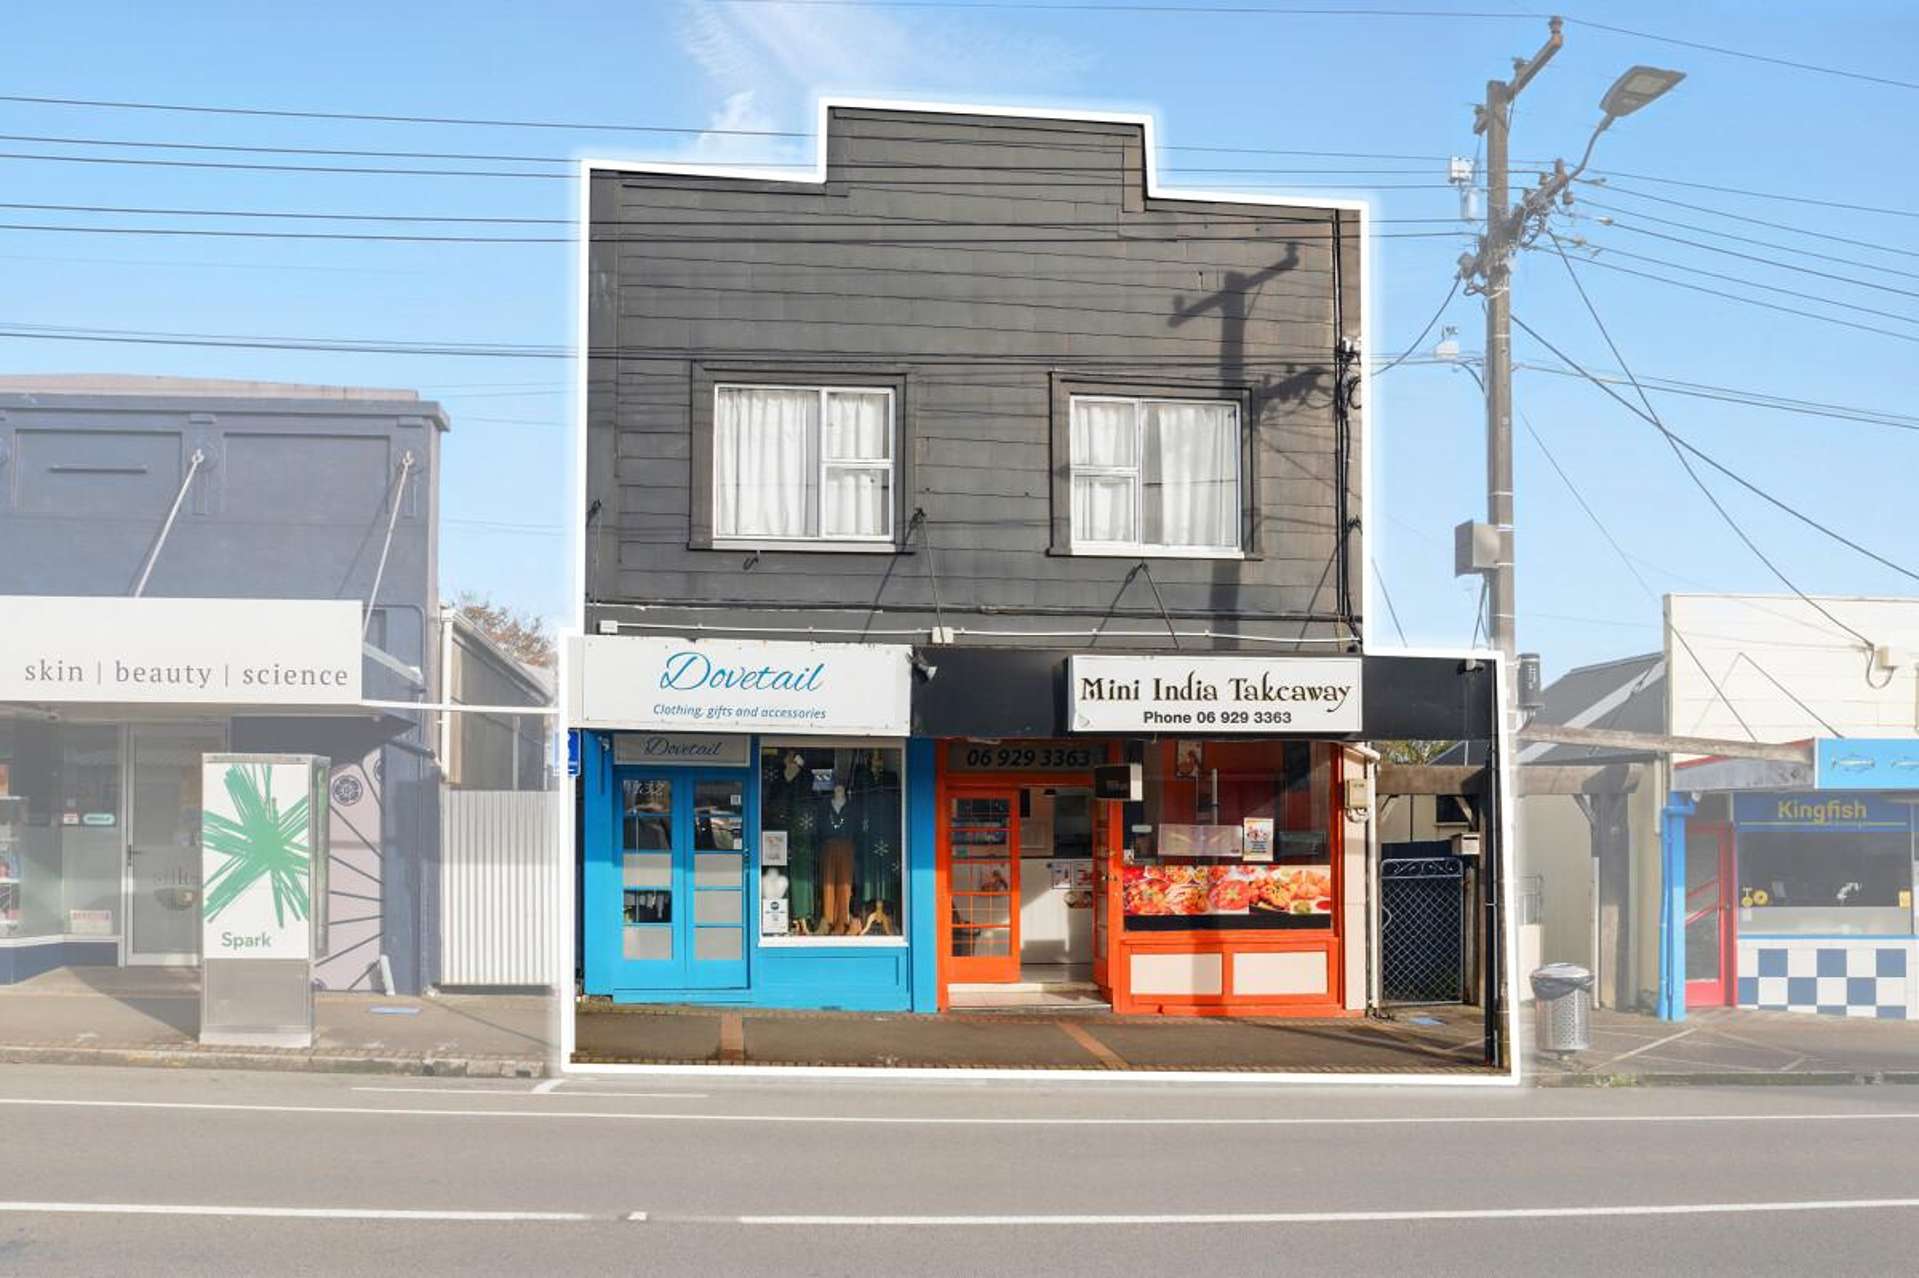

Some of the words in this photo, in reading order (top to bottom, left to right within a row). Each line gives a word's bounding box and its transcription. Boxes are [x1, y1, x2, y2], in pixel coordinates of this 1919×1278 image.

[24, 660, 84, 681] skin
[115, 661, 212, 688] beauty
[242, 664, 348, 686] science
[660, 652, 825, 691] Dovetail
[1081, 677, 1140, 700] Mini
[1152, 670, 1218, 701] India
[706, 705, 732, 719] gifts
[735, 706, 758, 718] and
[761, 707, 826, 719] accessories
[1143, 712, 1191, 724] Phone
[1197, 711, 1216, 724] 06
[1220, 711, 1249, 724] 929
[1254, 711, 1292, 724] 3363
[644, 736, 722, 756] Dovetail
[967, 750, 991, 767] 06
[997, 750, 1035, 767] 929
[1040, 750, 1090, 767] 3363
[1778, 801, 1867, 824] Kingfish
[221, 932, 272, 950] Spark
